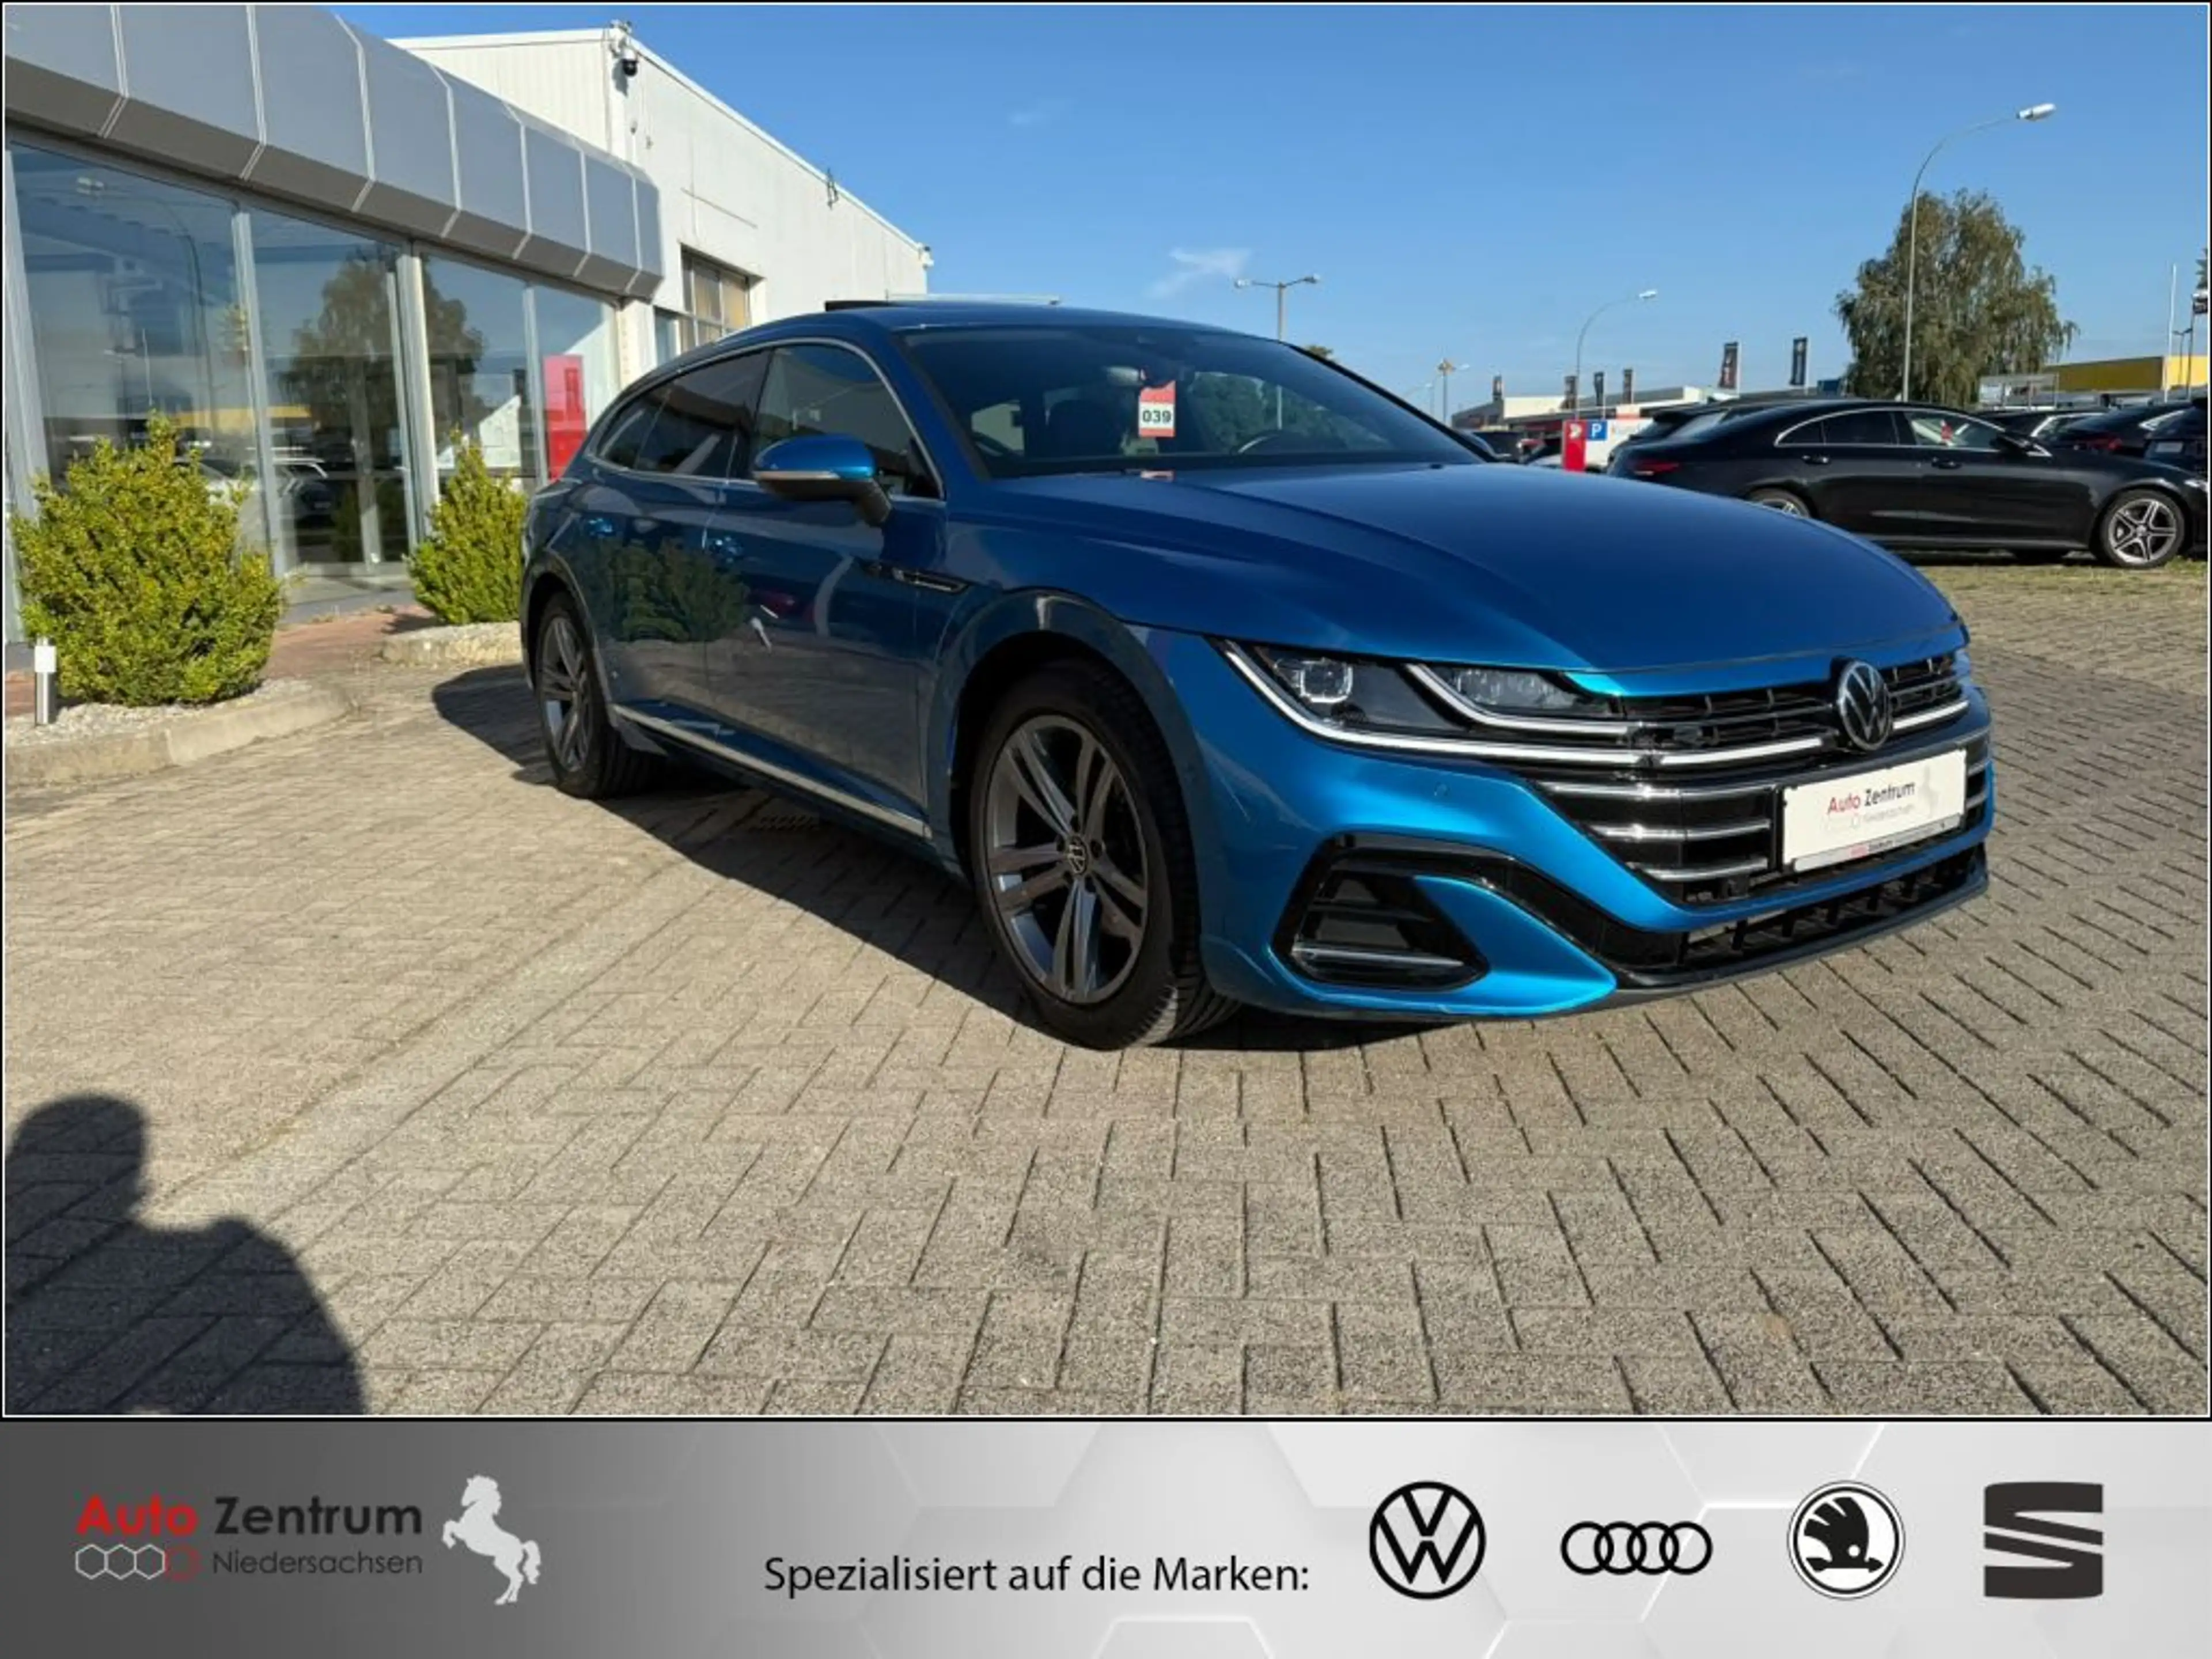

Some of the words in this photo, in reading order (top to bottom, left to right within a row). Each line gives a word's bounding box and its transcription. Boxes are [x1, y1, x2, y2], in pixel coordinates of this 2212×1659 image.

[1142, 410, 1172, 422] 039
[1592, 423, 1602, 438] P
[1827, 793, 1861, 815] Auto
